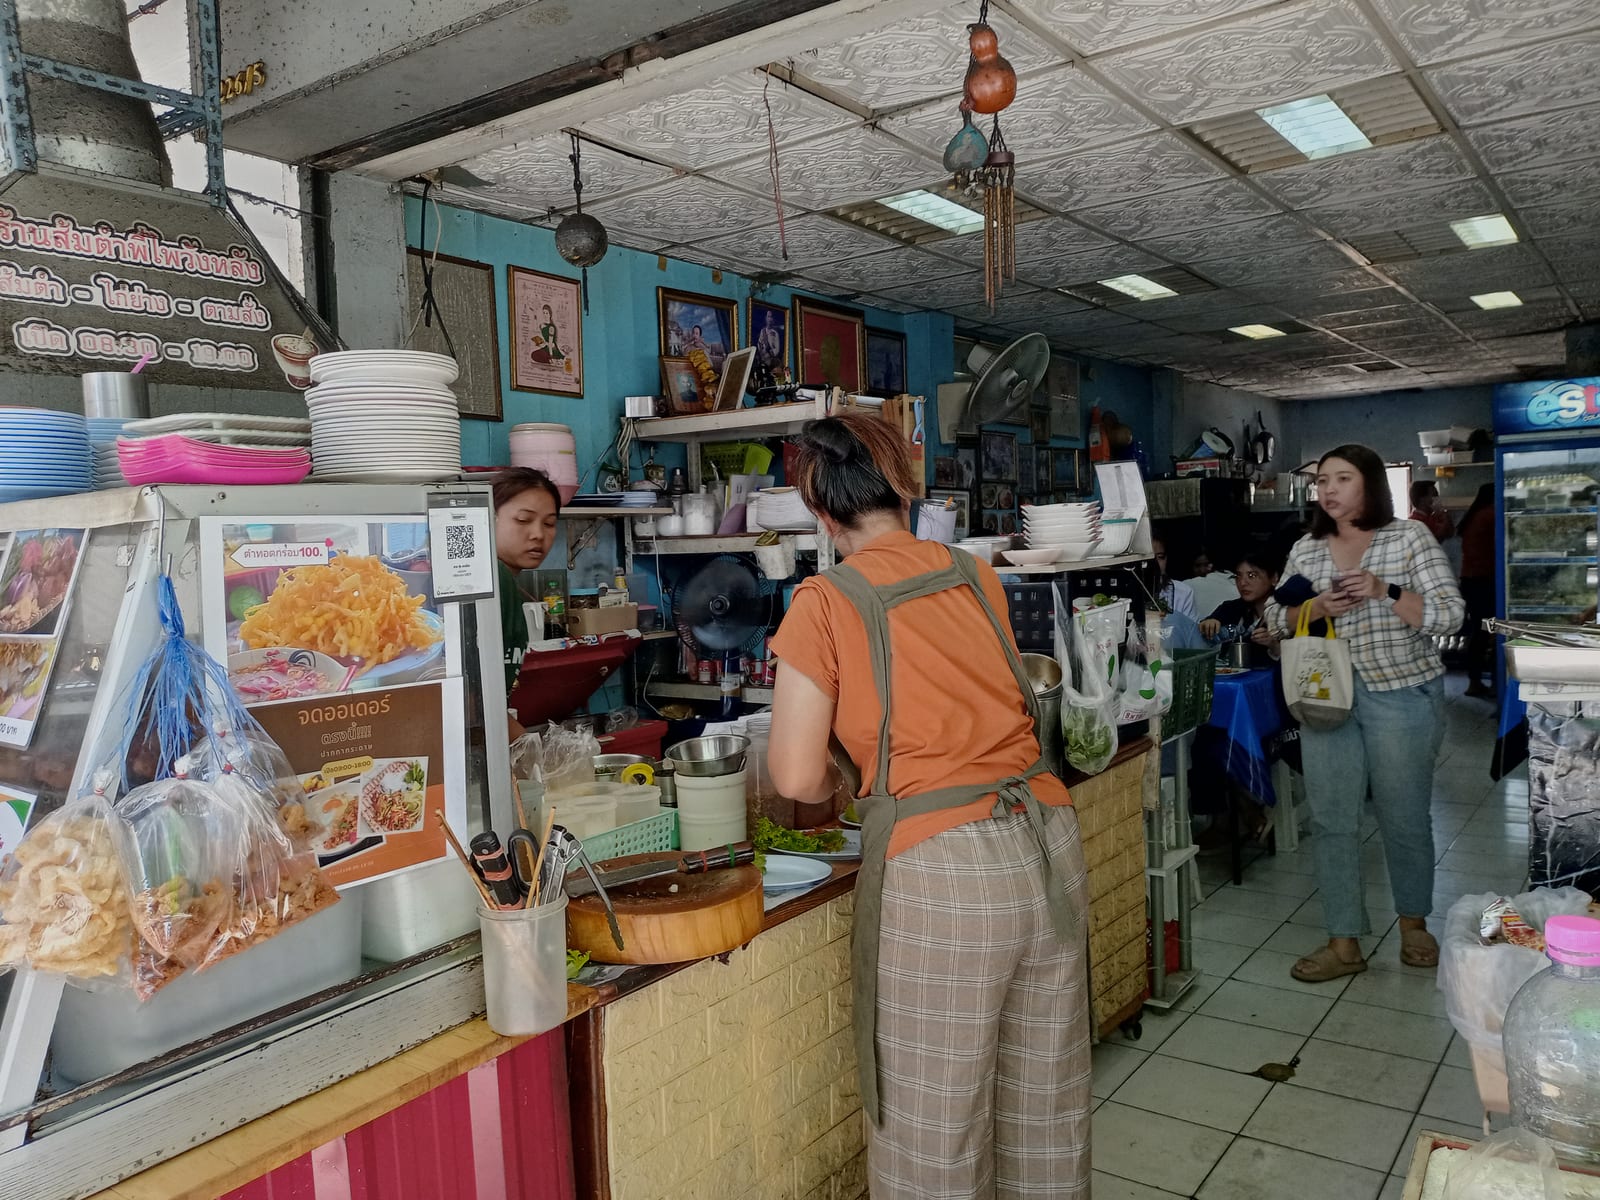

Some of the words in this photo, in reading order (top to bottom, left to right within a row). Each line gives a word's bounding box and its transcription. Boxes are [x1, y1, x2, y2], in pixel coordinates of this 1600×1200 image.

[0, 266, 64, 302] ส้มตำ
[99, 278, 168, 313] ไก่ย่าง
[203, 293, 266, 326] ตามสั่ง
[20, 323, 67, 351] เปิด
[298, 694, 392, 725] จดออเดอร์
